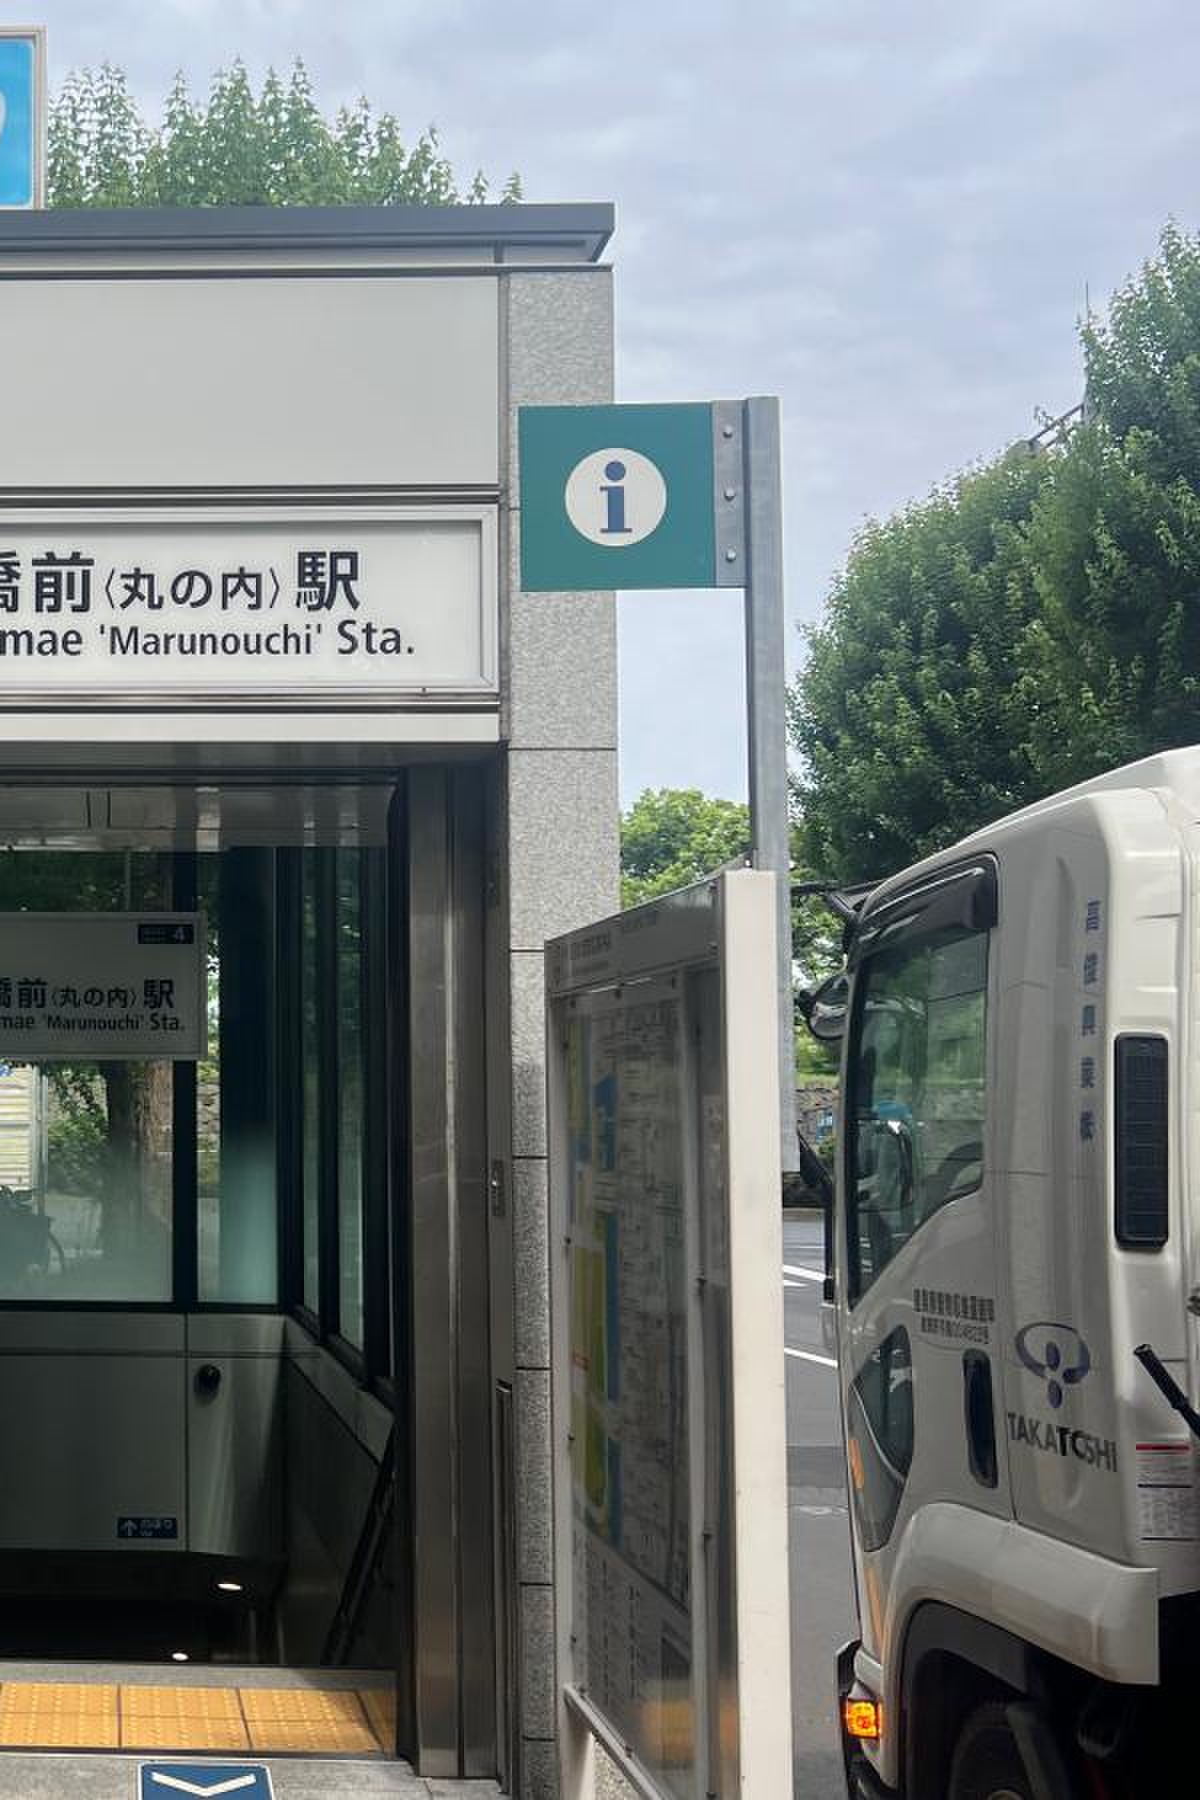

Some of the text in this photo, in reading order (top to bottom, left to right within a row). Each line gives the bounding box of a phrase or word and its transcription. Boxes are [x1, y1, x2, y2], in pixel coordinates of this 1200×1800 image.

[99, 624, 322, 656] 'Marunouchi'
[336, 619, 415, 656] Sta.
[150, 1012, 185, 1031] Sta.
